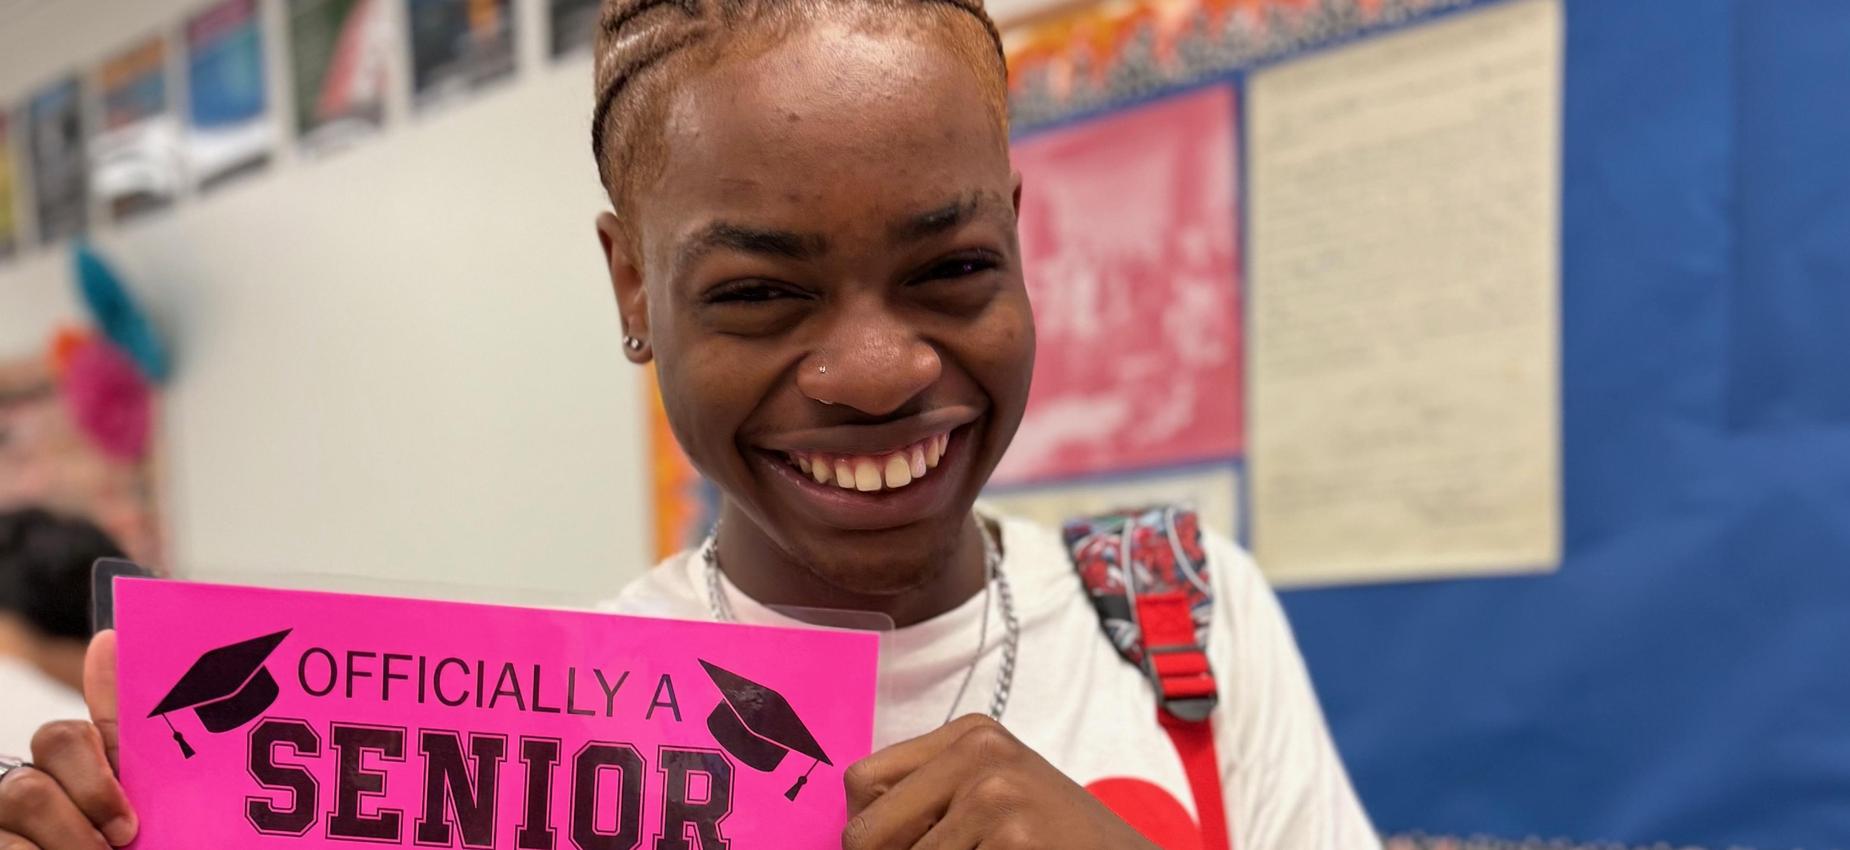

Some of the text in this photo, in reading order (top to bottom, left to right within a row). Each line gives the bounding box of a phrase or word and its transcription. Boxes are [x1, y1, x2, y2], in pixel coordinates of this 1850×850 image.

[298, 647, 682, 722] OFFICIALLY A
[245, 718, 735, 850] SENIOR
